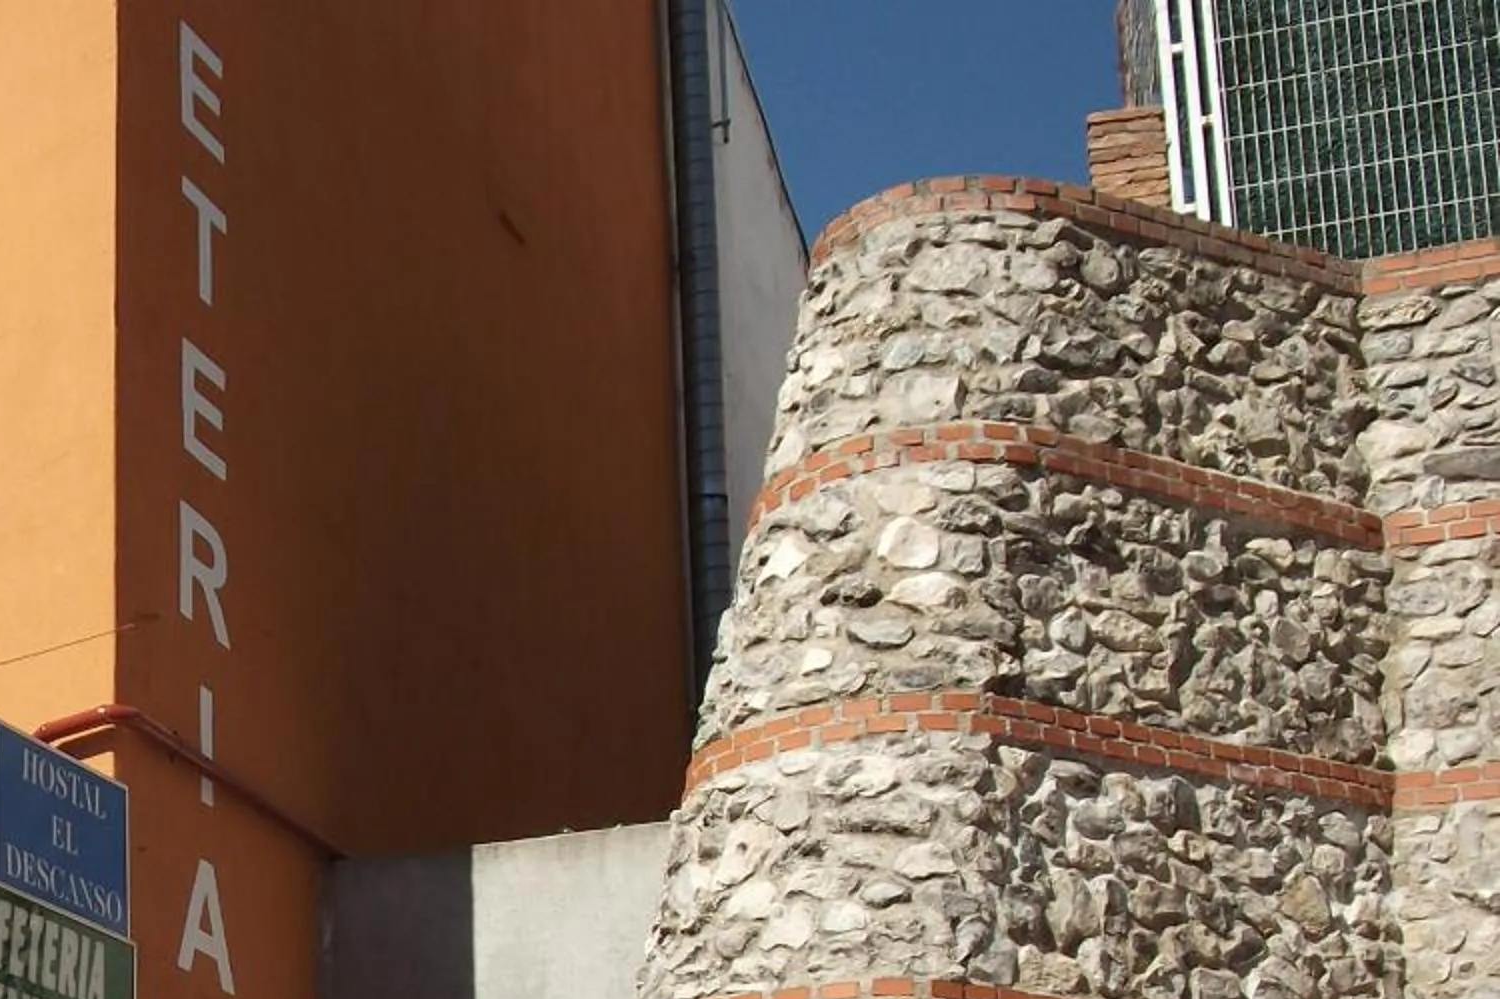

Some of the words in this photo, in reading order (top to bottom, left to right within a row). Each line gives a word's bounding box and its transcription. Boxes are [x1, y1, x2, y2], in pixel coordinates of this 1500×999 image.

[177, 18, 235, 995] ETERIA
[22, 747, 107, 820] HOSTAL
[52, 814, 79, 857] EL
[5, 841, 123, 924] DESCANSO
